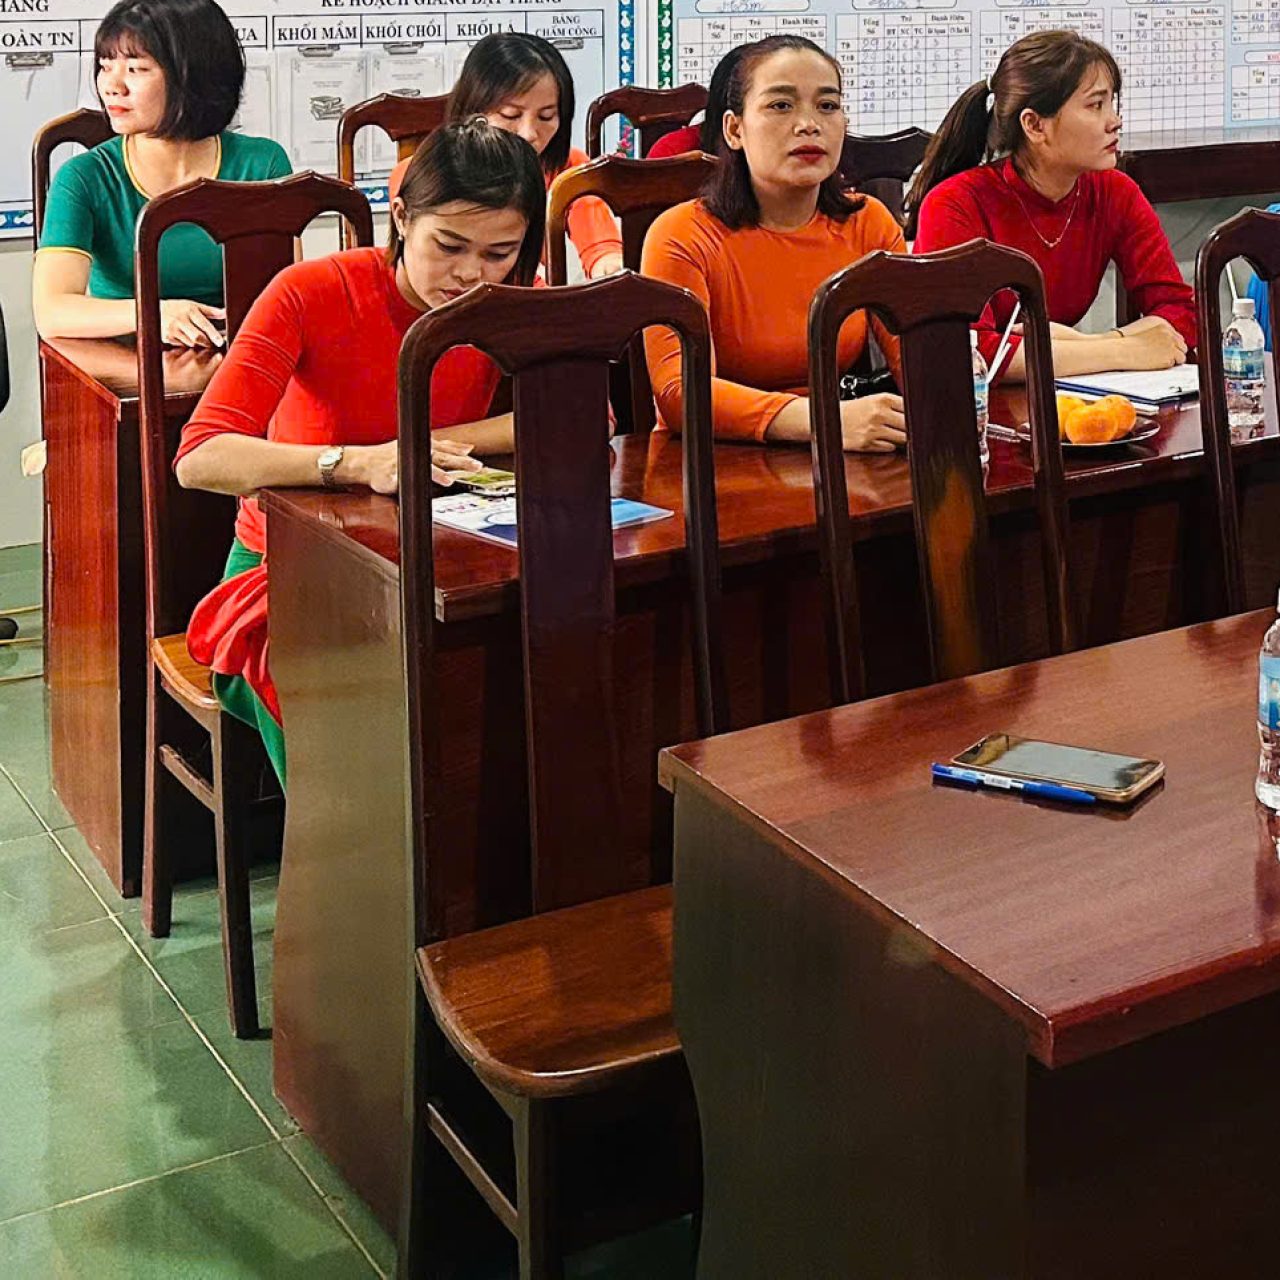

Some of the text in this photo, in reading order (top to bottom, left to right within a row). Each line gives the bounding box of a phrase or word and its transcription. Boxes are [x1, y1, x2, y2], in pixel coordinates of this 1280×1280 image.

[277, 20, 358, 40] KHỐI MẦM
[365, 16, 442, 39] KHỐI CHỒI
[48, 32, 74, 46] TN
